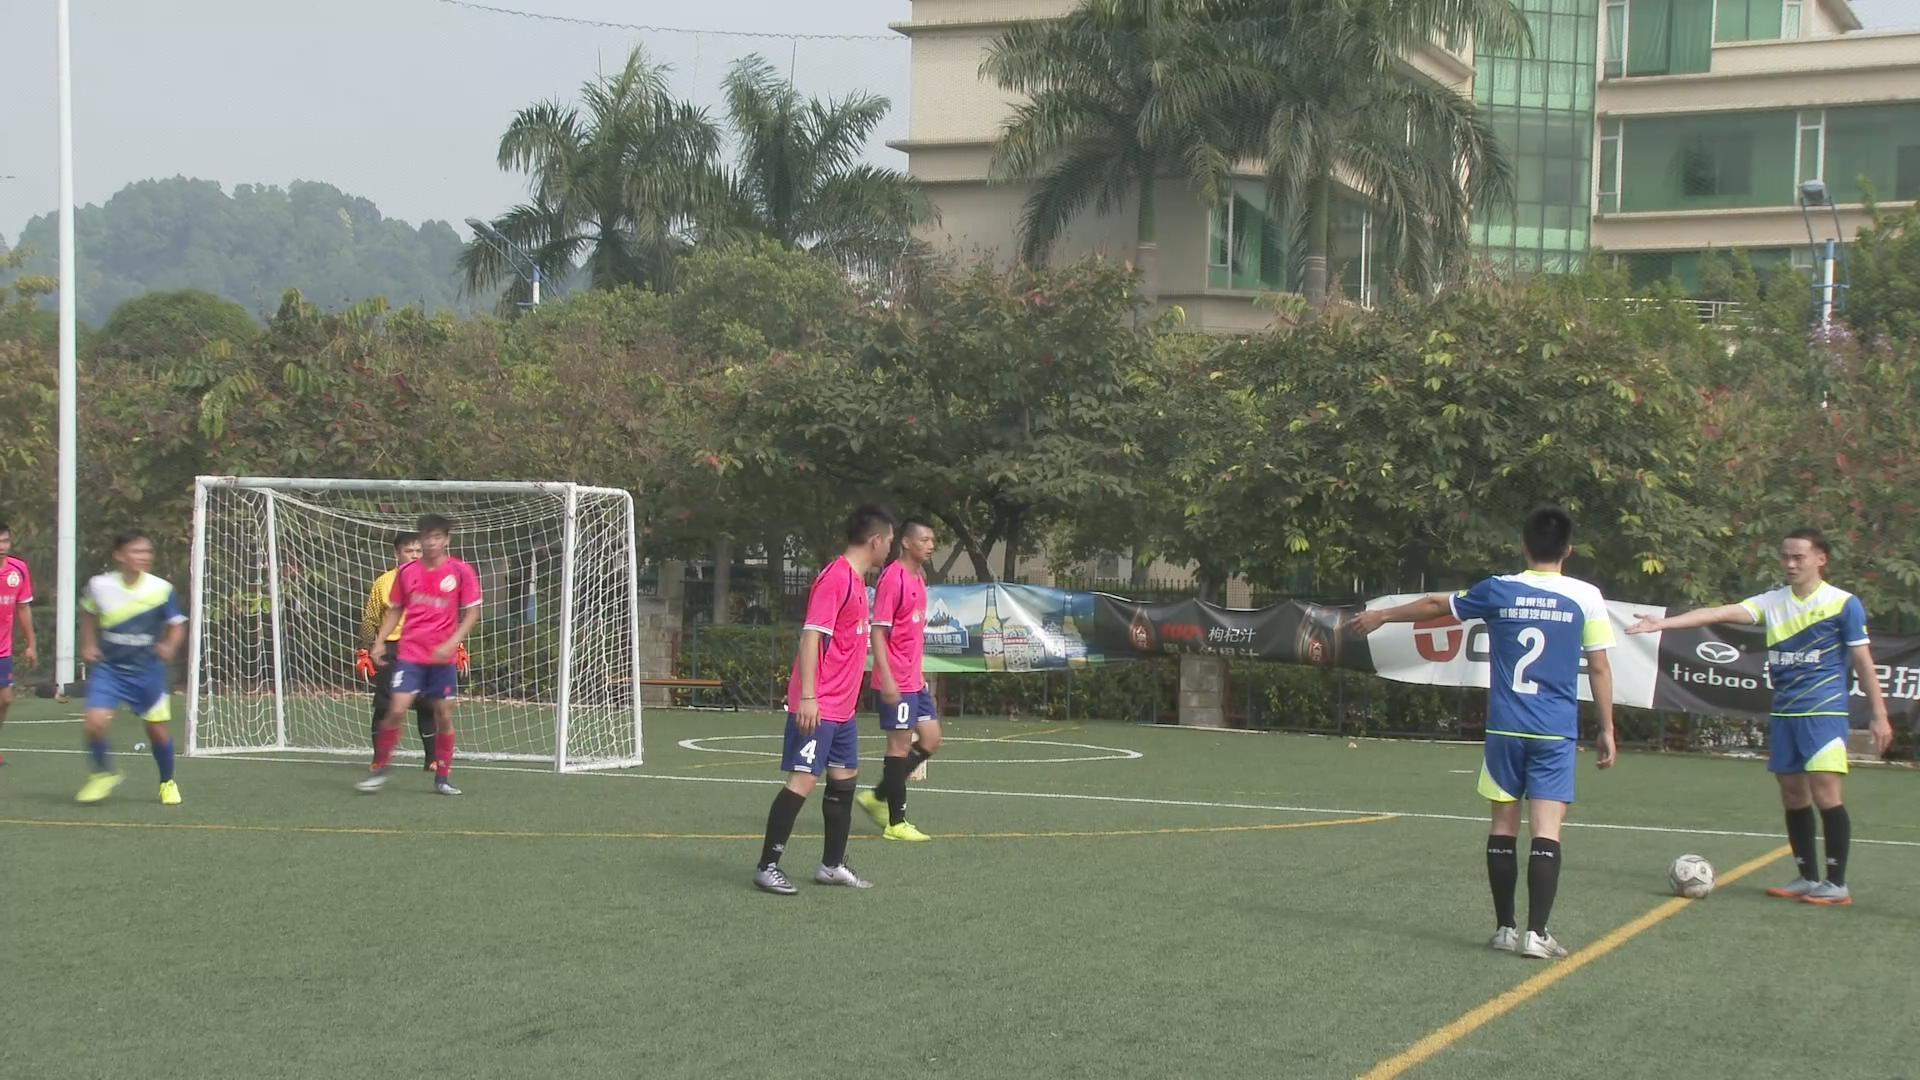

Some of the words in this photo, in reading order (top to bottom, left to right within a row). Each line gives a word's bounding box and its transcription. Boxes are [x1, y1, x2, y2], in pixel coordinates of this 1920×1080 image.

[1208, 626, 1257, 643] 枸杞汁
[1511, 626, 1546, 695] 2
[1671, 662, 1758, 690] tiebao
[897, 702, 910, 724] 0
[799, 739, 818, 765] 4
